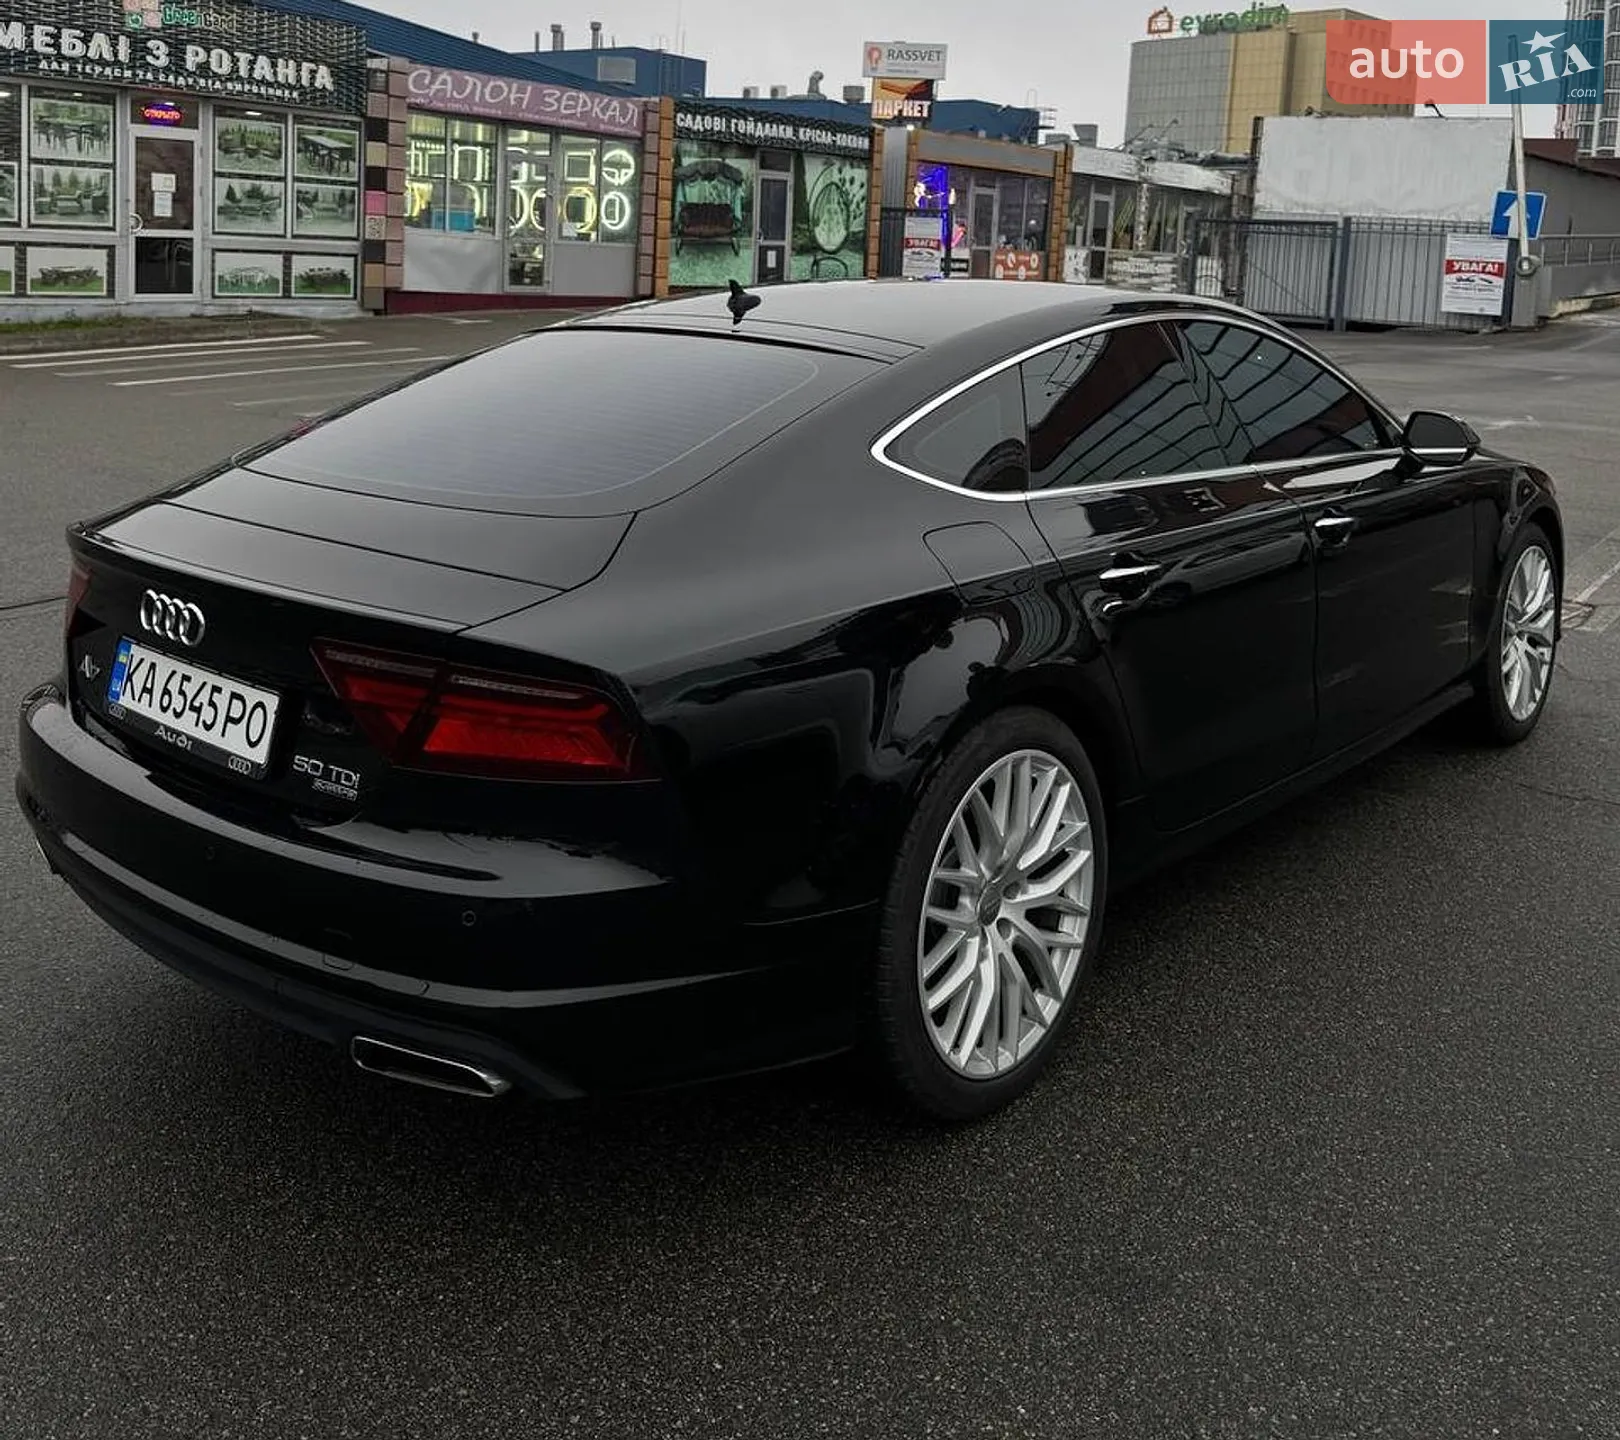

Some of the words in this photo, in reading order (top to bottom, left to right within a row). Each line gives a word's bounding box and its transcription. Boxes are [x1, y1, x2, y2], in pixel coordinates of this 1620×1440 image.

[0, 21, 131, 63] МЕБЛІ
[145, 39, 170, 68] З
[184, 44, 334, 91] РОТАНГА
[887, 48, 943, 62] RASSVET
[407, 68, 533, 110] САЛОН
[539, 88, 639, 127] ЗЕРКАЛ
[871, 99, 932, 119] ПАРКЕТ
[676, 112, 727, 133] САДОВІ
[1453, 261, 1499, 273] УВАГА!
[154, 724, 194, 751] Audi
[293, 755, 324, 775] 50
[328, 764, 360, 788] TDI
